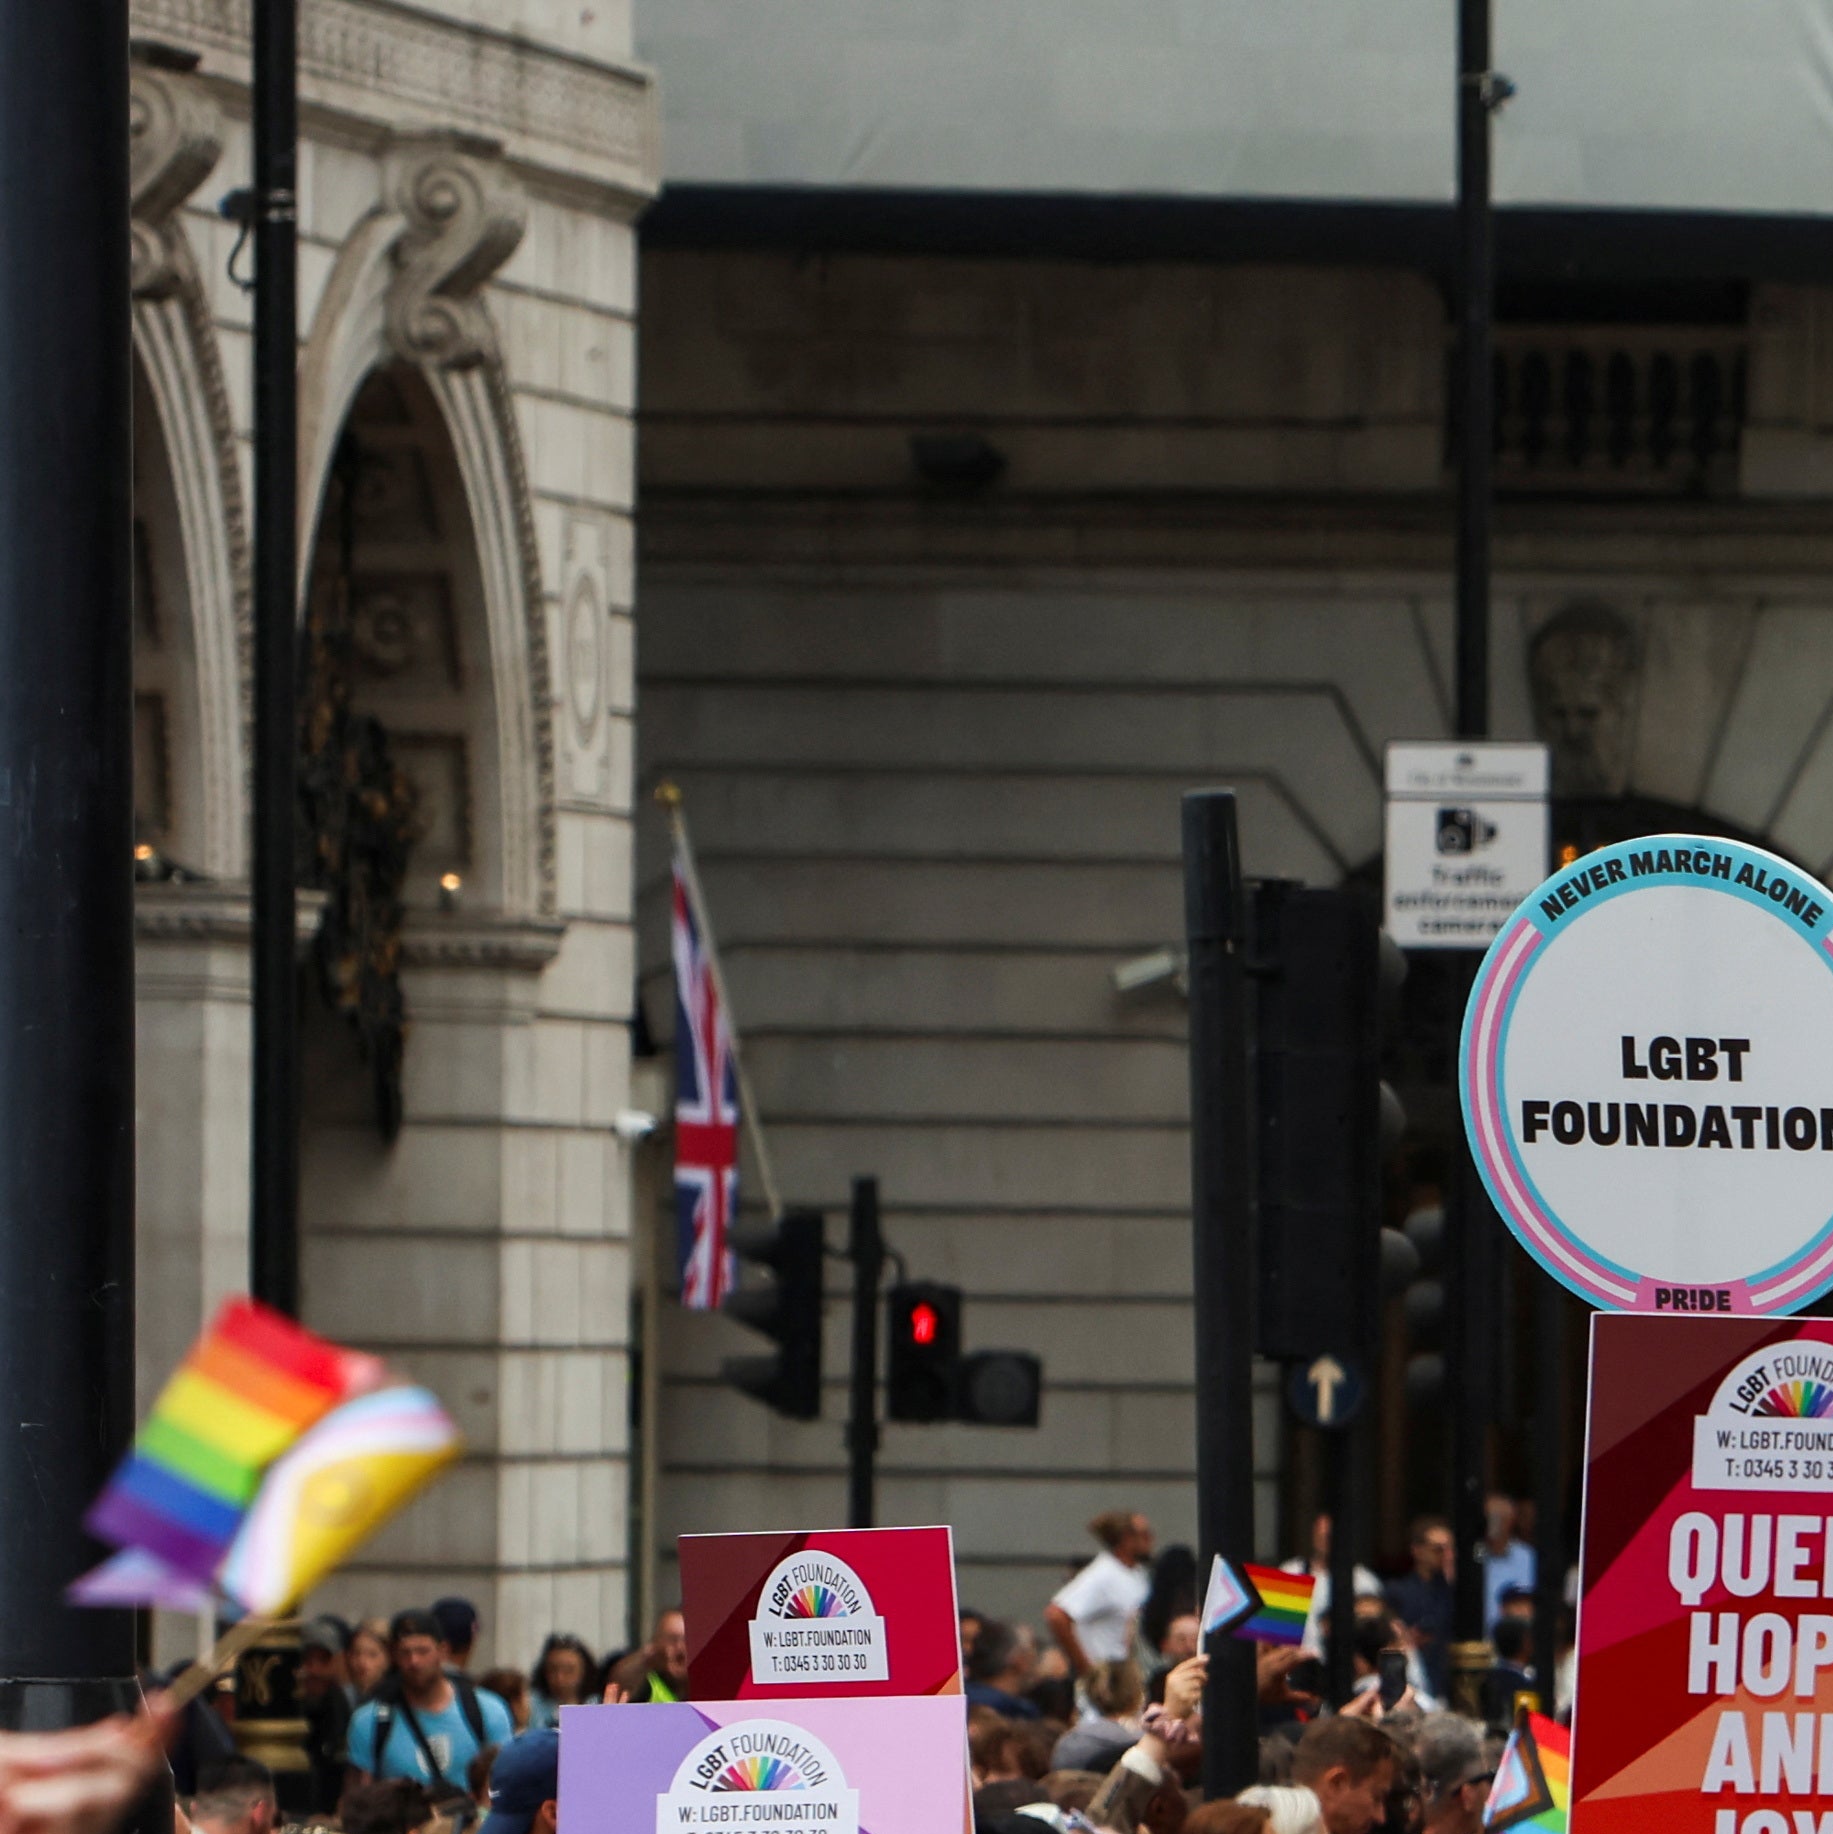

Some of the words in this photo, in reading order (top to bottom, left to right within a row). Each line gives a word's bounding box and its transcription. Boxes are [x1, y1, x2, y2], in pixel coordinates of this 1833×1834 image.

[1539, 858, 1626, 922] NEVER
[1629, 850, 1729, 879] MARCH
[1734, 863, 1824, 928] ALONE
[1621, 1035, 1750, 1082] LGBT
[1729, 1366, 1772, 1414] LGBT
[1717, 1430, 1736, 1448] W:
[1726, 1458, 1740, 1477] T:
[1744, 1459, 1783, 1478] 0345
[1789, 1461, 1798, 1478] 3
[1803, 1461, 1822, 1479] 30
[769, 1575, 792, 1616] LGBT
[792, 1564, 861, 1614] FOUNDATION
[784, 1656, 810, 1672] 0345
[812, 1655, 818, 1670] 3
[822, 1655, 834, 1670] 30
[838, 1654, 850, 1669] 30
[854, 1654, 866, 1669] 30
[689, 1746, 728, 1790] LGBT
[730, 1733, 828, 1787] FOUNDATION
[678, 1806, 697, 1822] W:
[701, 1803, 838, 1822] LGBT.FOUNDATION
